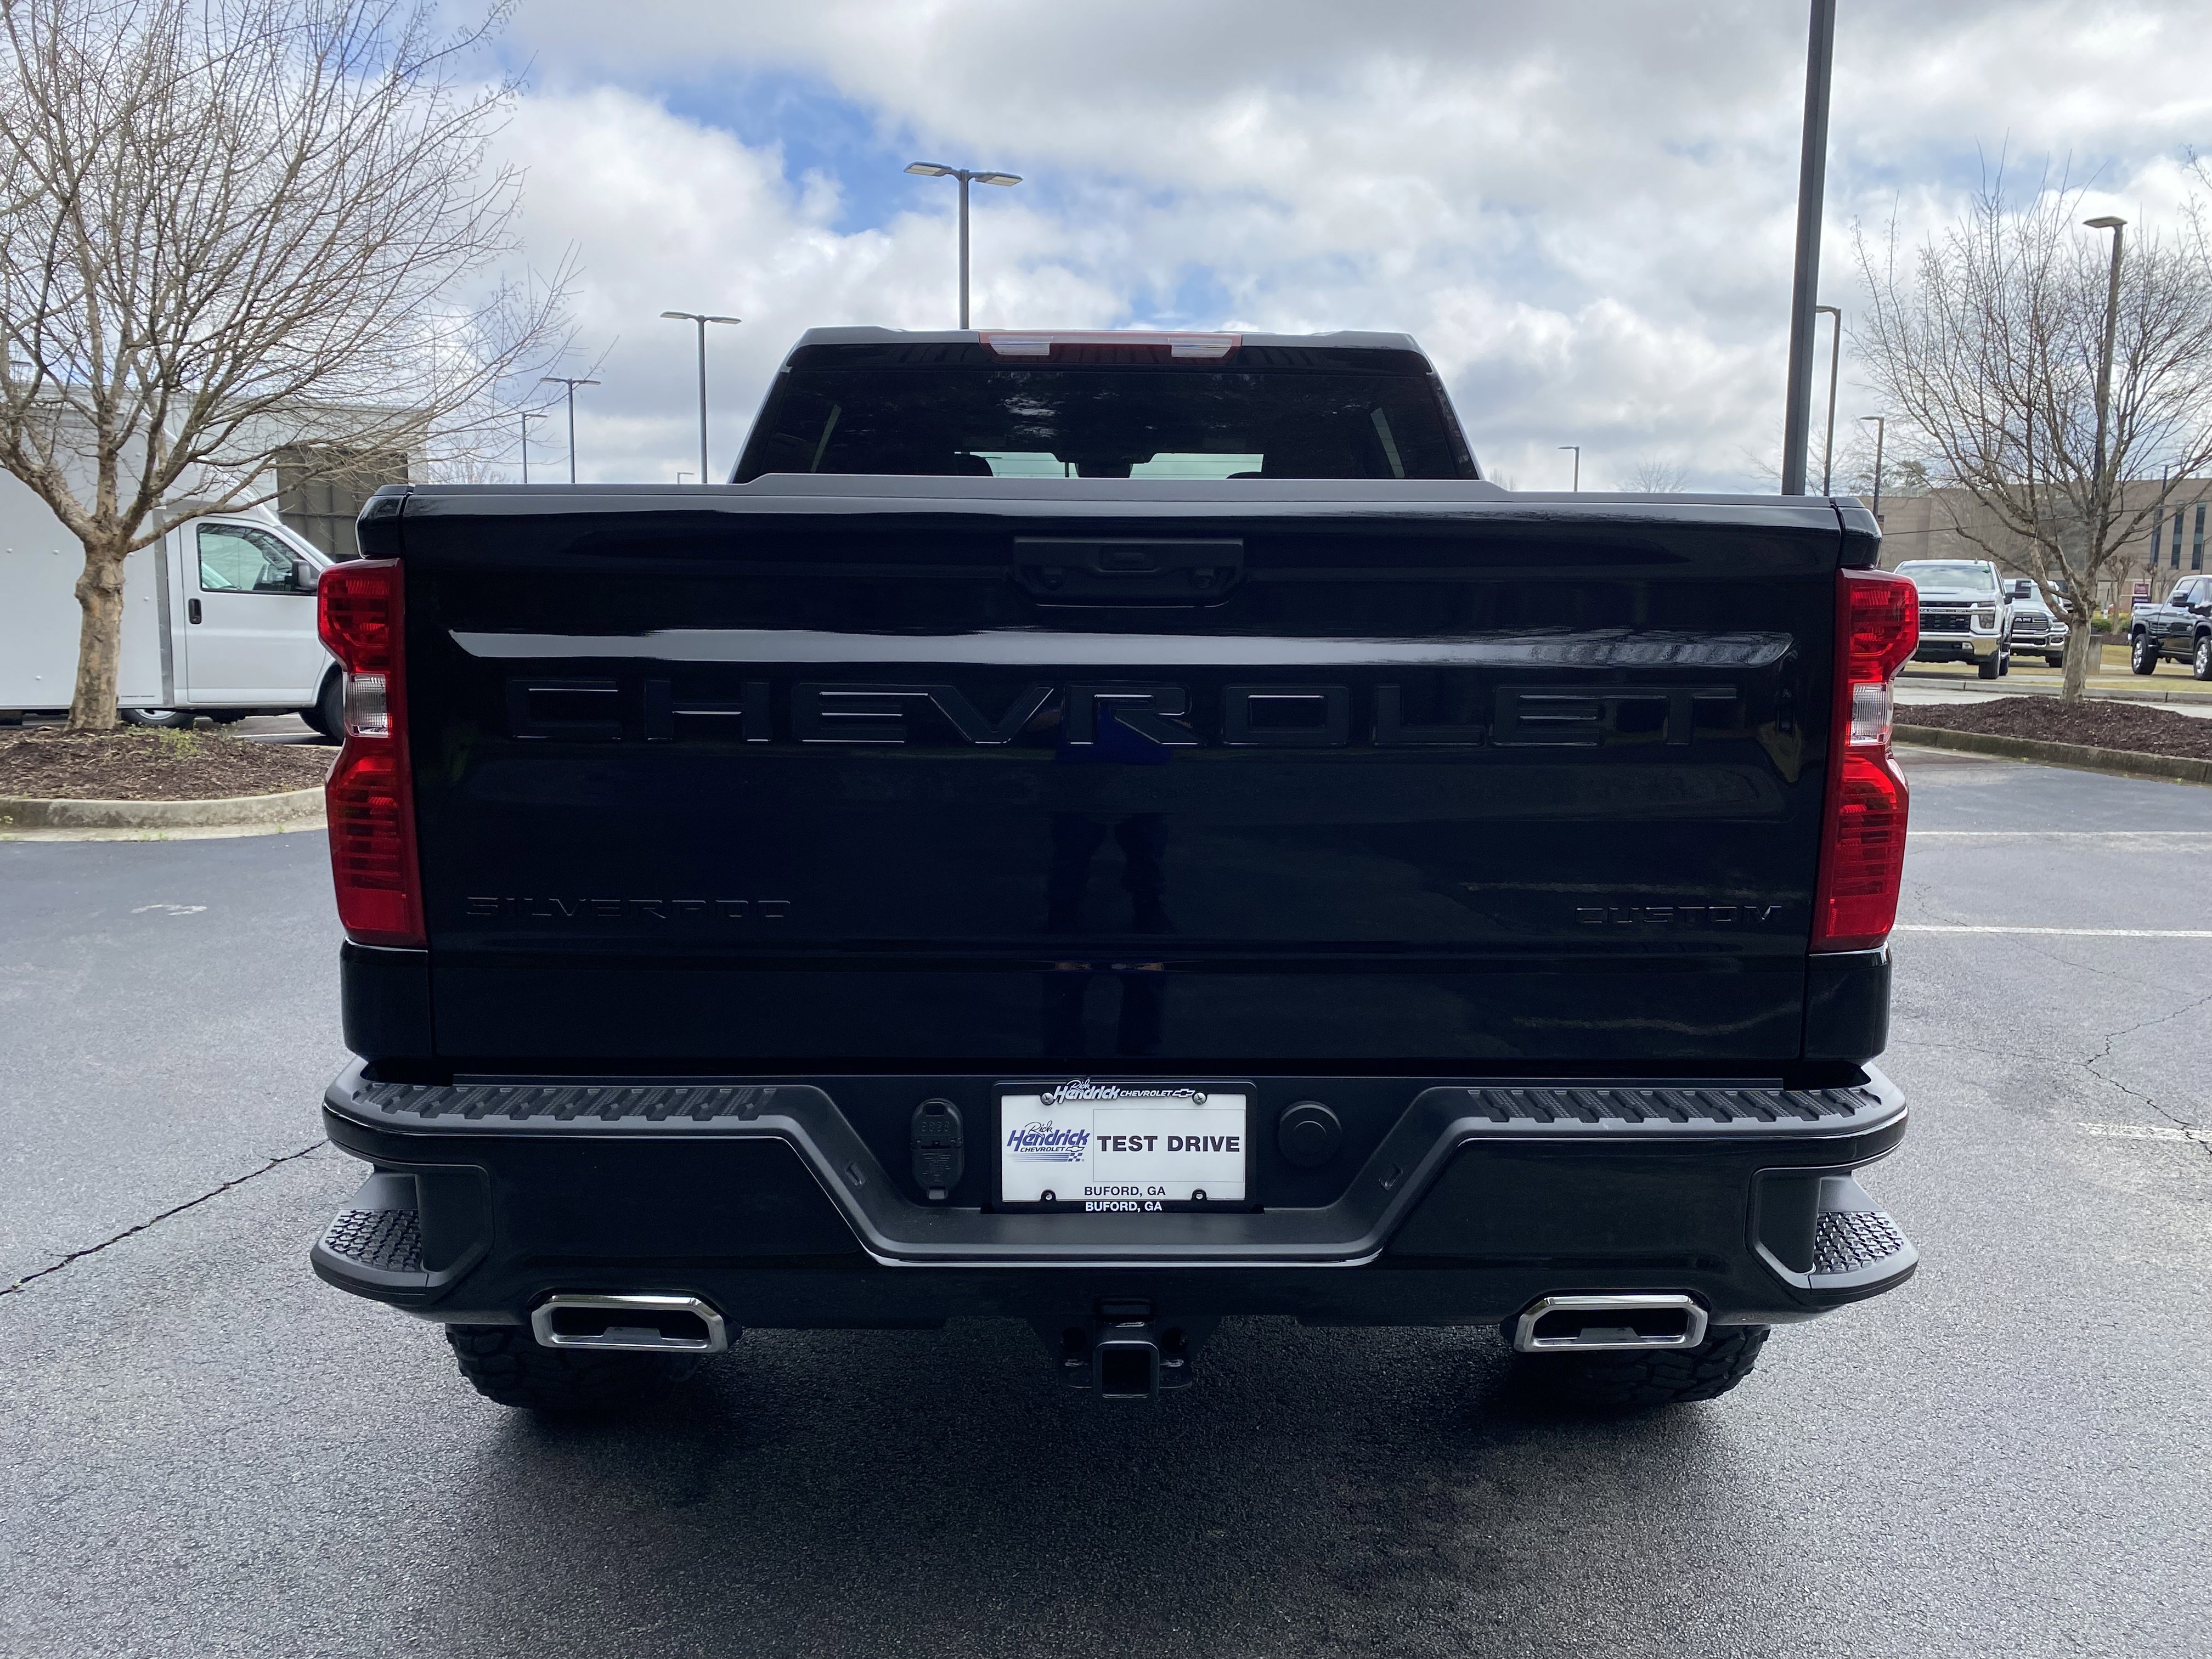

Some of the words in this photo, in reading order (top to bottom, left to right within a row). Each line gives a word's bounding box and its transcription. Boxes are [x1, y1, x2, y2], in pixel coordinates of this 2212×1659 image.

[506, 678, 1738, 746] CHEVROLET
[465, 896, 791, 919] SILVERADO
[1575, 905, 1783, 924] CUSTOM
[1053, 1085, 1121, 1104] Hendrick
[1066, 1078, 1091, 1093] Rick
[1024, 1120, 1053, 1136] Rick
[1006, 1129, 1091, 1152] Hendrick
[1097, 1135, 1158, 1152] TEST
[1167, 1136, 1240, 1153] DRIVE
[1084, 1186, 1142, 1197] BUFORD,
[1147, 1186, 1166, 1196] GA
[1085, 1201, 1141, 1213] BUFORD,
[1144, 1201, 1163, 1211] GA
